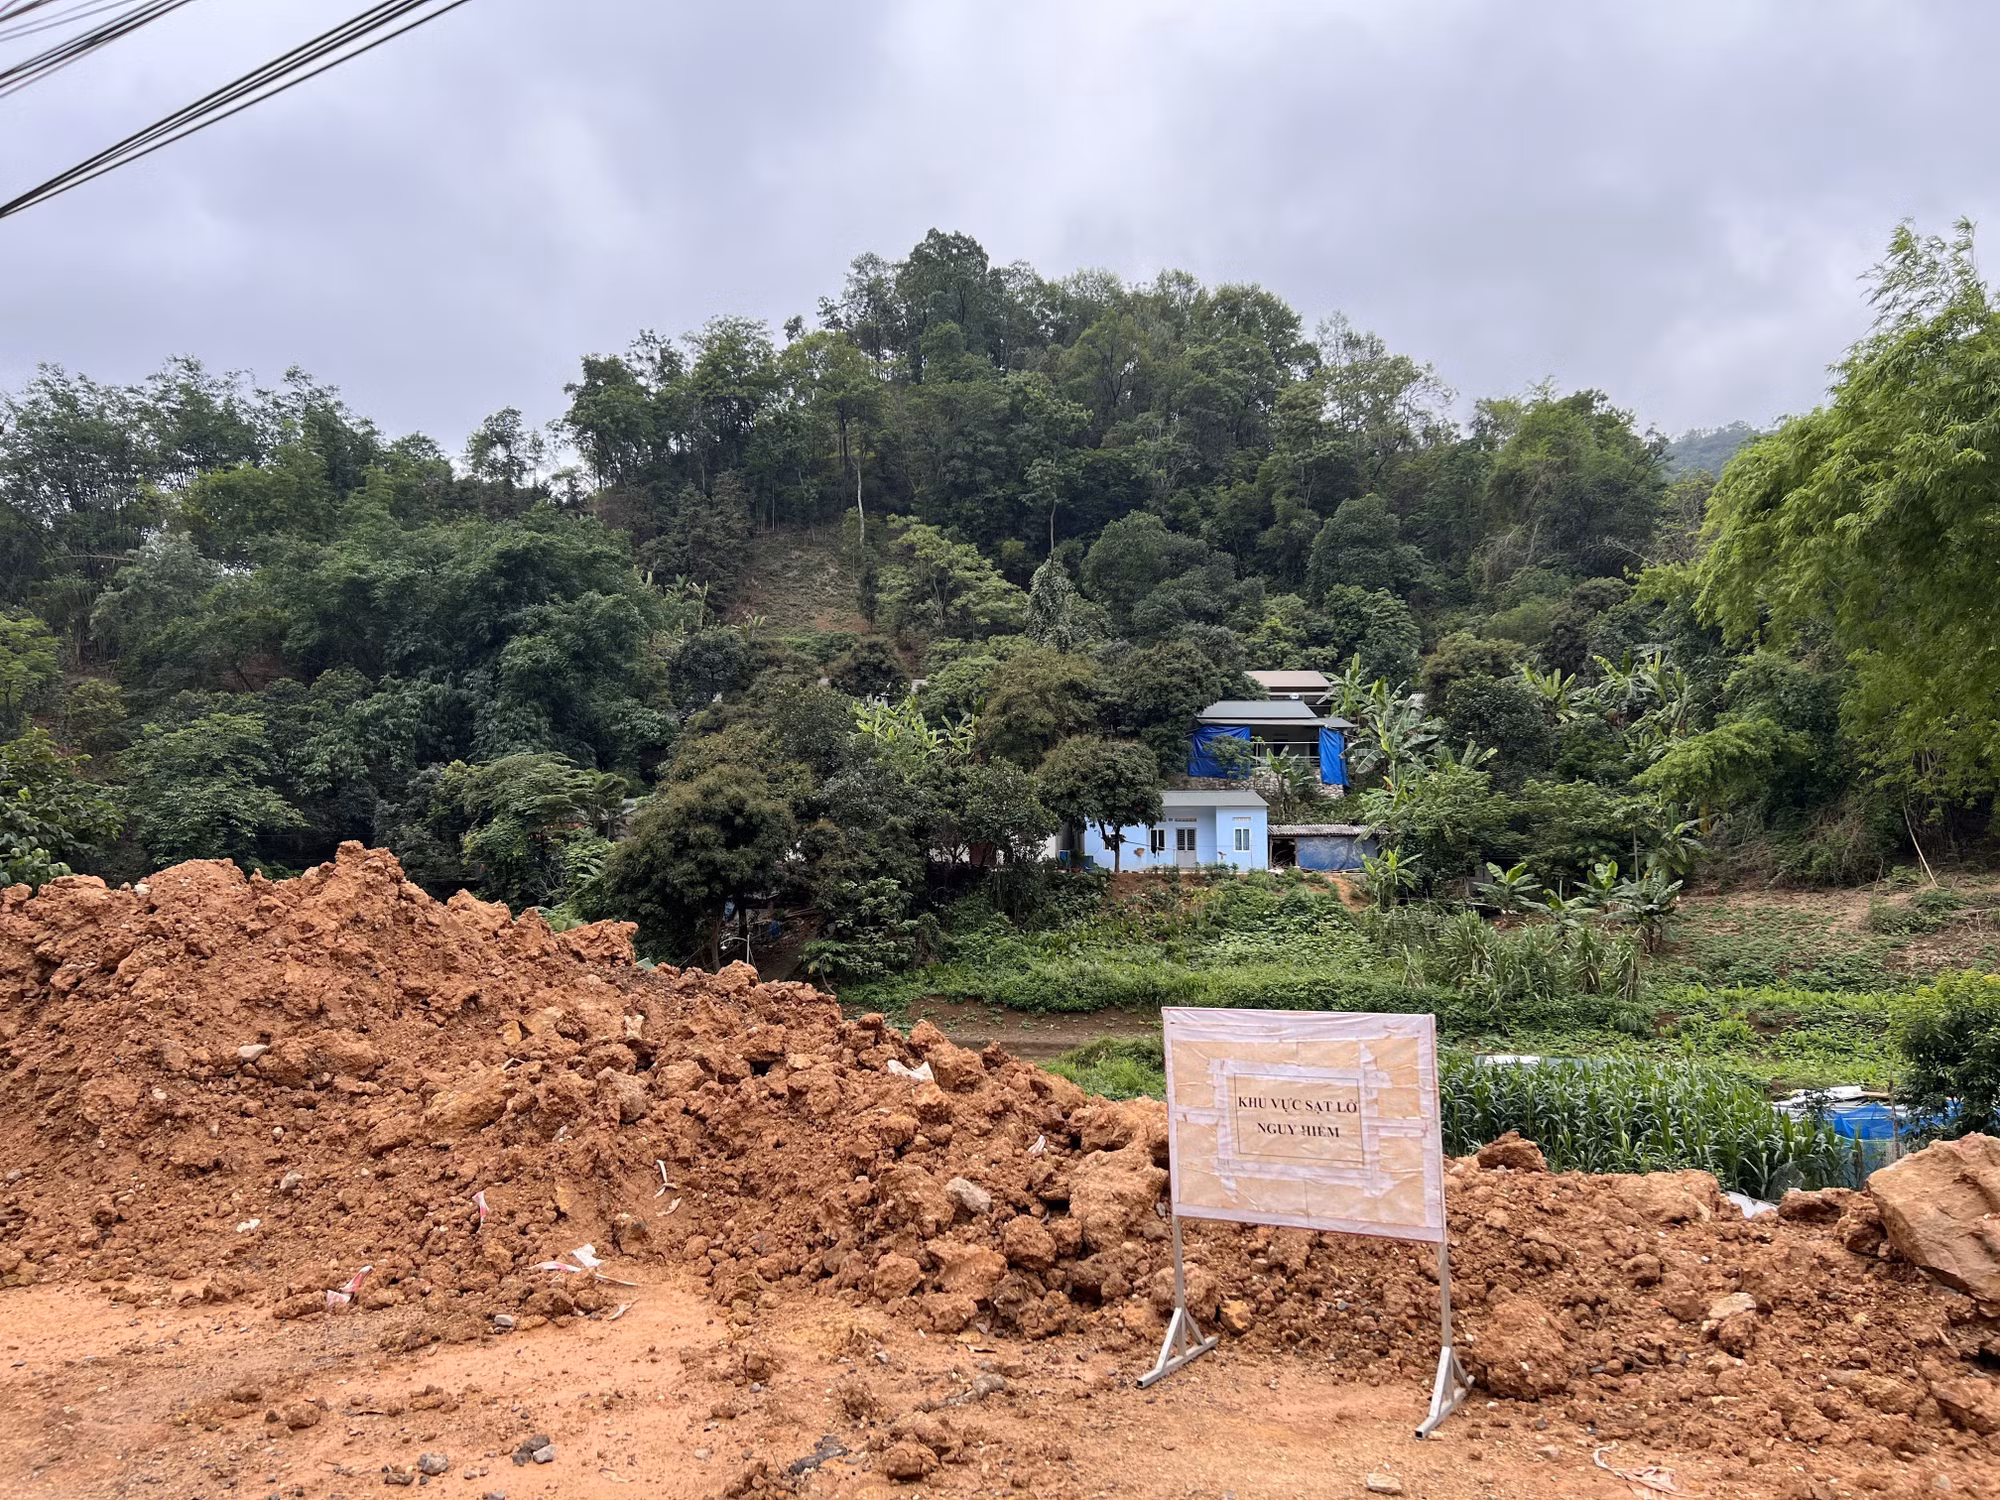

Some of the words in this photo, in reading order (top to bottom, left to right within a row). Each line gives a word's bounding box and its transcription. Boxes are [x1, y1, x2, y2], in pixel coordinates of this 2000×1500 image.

[1238, 1096, 1267, 1109] KHU
[1271, 1097, 1302, 1113] VỰC
[1305, 1100, 1333, 1115] SẠT
[1257, 1122, 1297, 1135] NGUY
